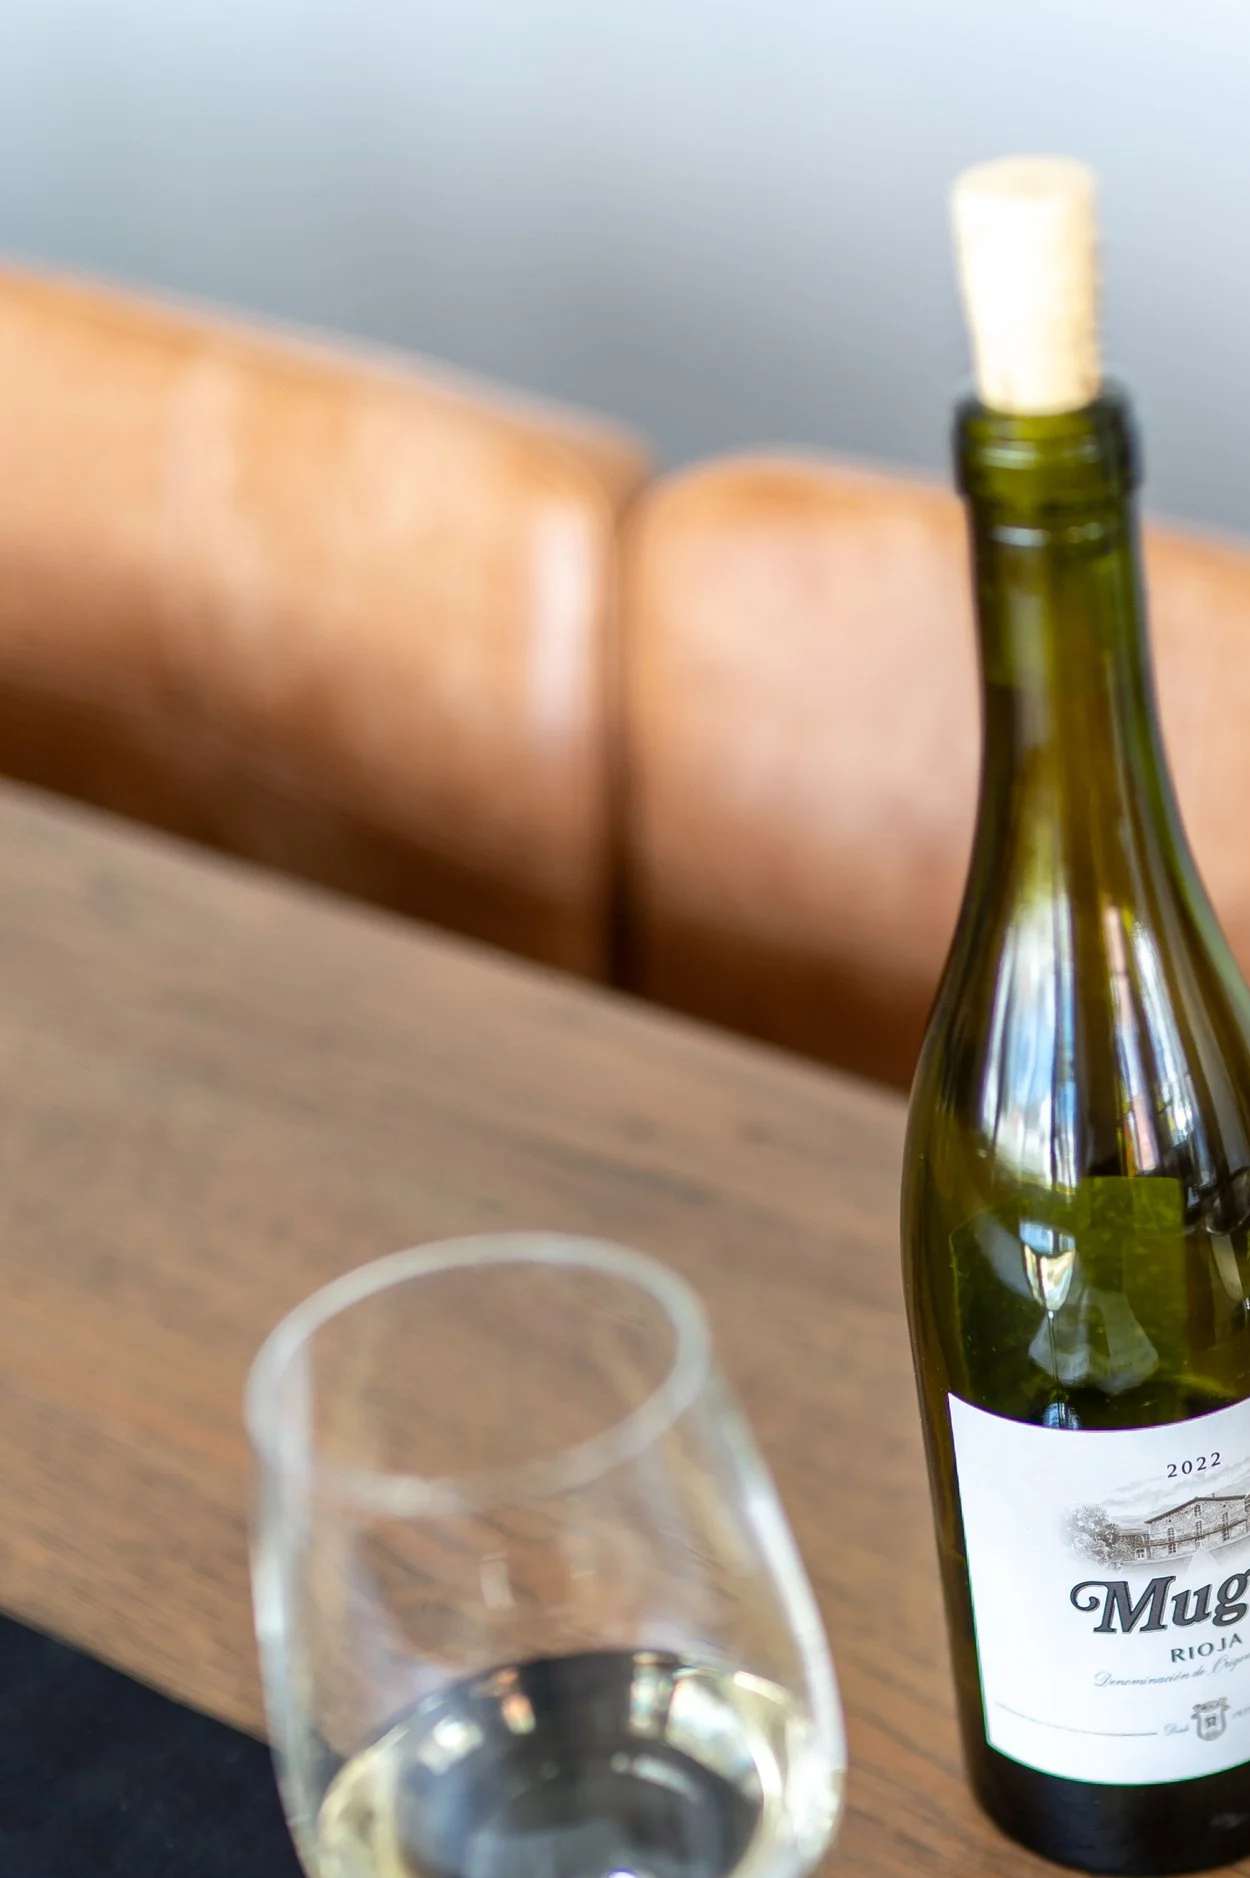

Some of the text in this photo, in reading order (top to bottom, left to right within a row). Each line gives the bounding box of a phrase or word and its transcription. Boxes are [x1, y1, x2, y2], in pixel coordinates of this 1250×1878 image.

[1166, 1451, 1222, 1478] 2022
[1170, 1633, 1243, 1664] RIOJA
[1192, 1664, 1207, 1678] de
